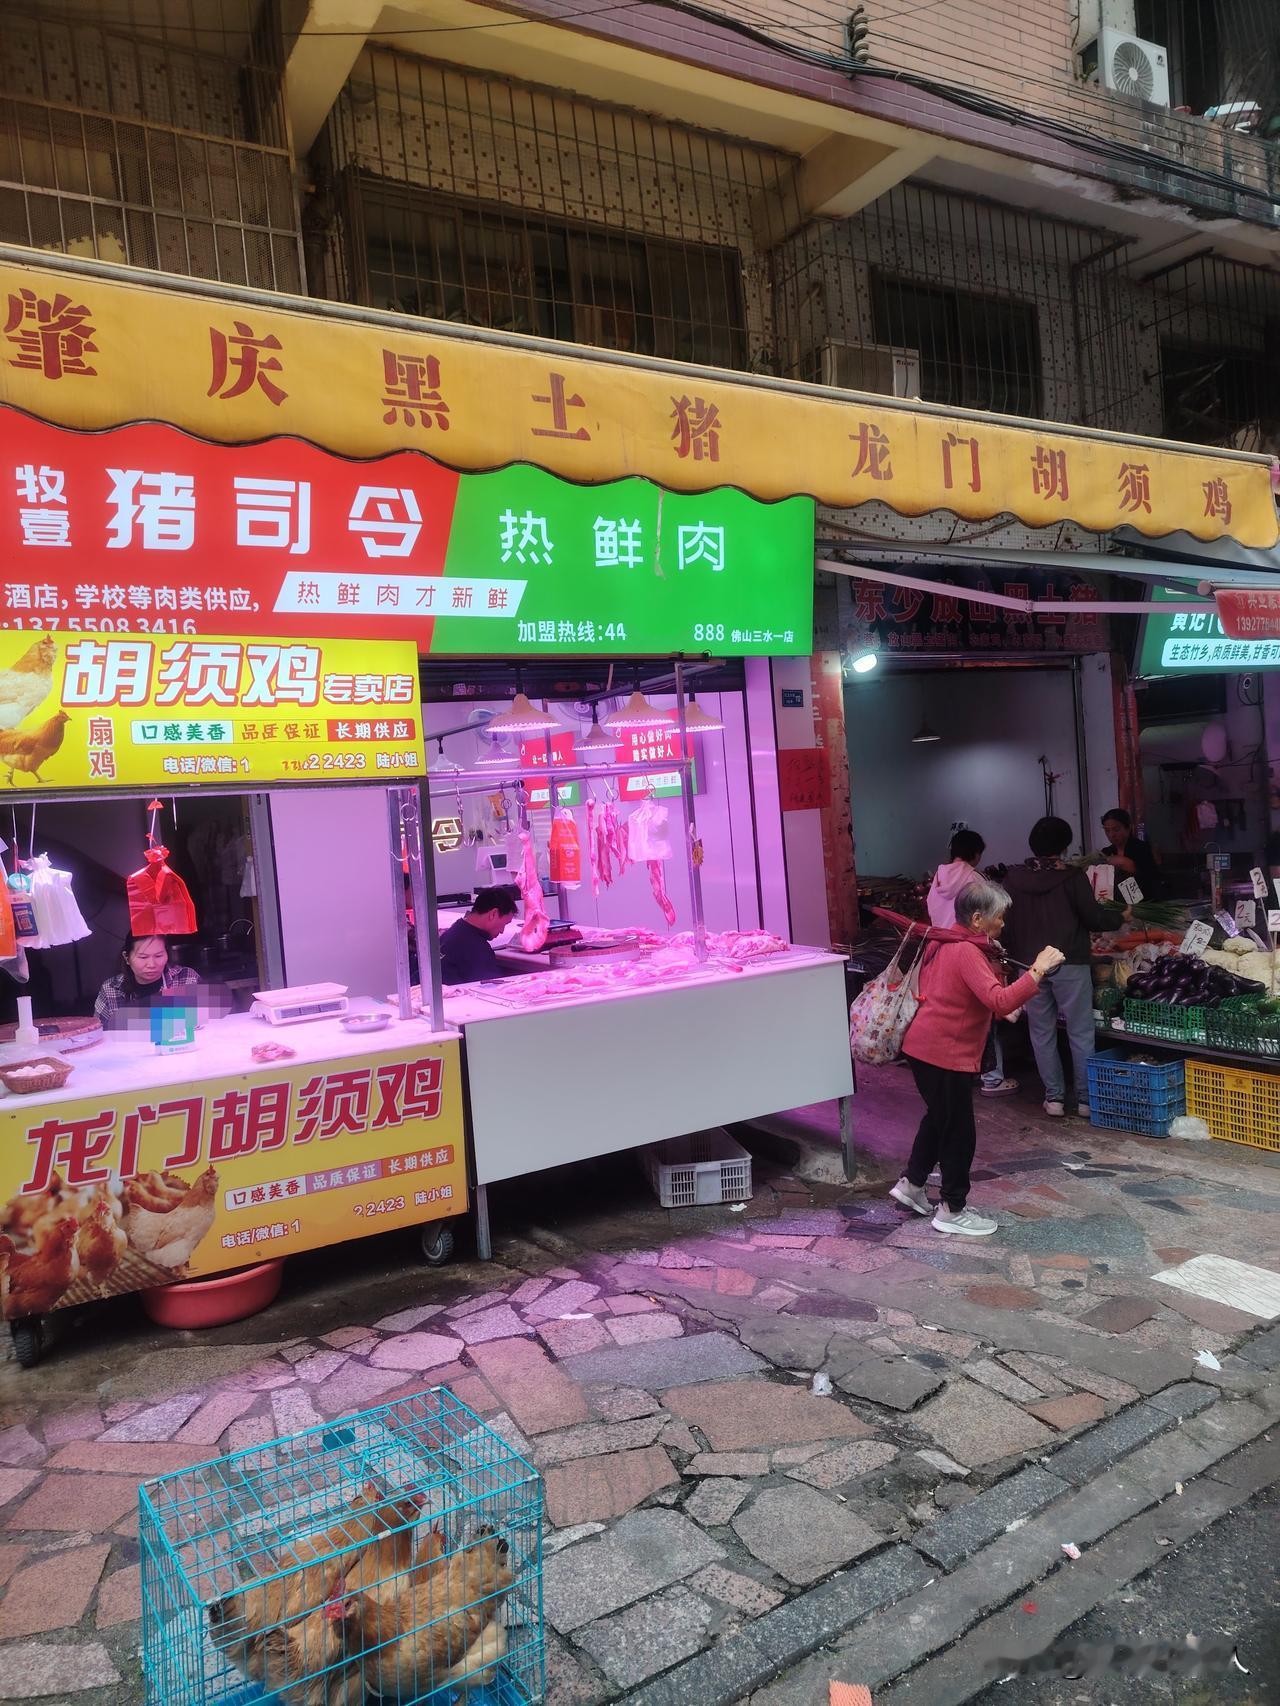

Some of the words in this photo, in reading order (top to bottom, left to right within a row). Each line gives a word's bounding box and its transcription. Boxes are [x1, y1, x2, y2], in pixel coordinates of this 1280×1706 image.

[3, 287, 721, 462] 肇庆黑土猪
[849, 422, 1232, 526] 龙门胡须鸡
[106, 468, 423, 558] 猪司令
[500, 508, 727, 572] 热鲜肉
[297, 580, 510, 611] 热鲜肉才新鲜
[731, 629, 794, 643] 佛山三水一店
[1169, 643, 1280, 663] 生态竹乡,肉质鲜美,甘香可
[61, 640, 322, 707] 胡须鸡
[323, 673, 414, 704] 专卖店
[87, 715, 116, 779] 扇鸡
[141, 723, 226, 741] 口感美香
[334, 721, 410, 739] 长期供应
[376, 751, 418, 769] 陆小姐
[20, 1057, 446, 1196] 龙门胡须鸡
[232, 1179, 302, 1207] 口感美香
[311, 1163, 377, 1191] 品质保证
[387, 1148, 450, 1174] 长期供应
[414, 1186, 454, 1206] 陆小姐
